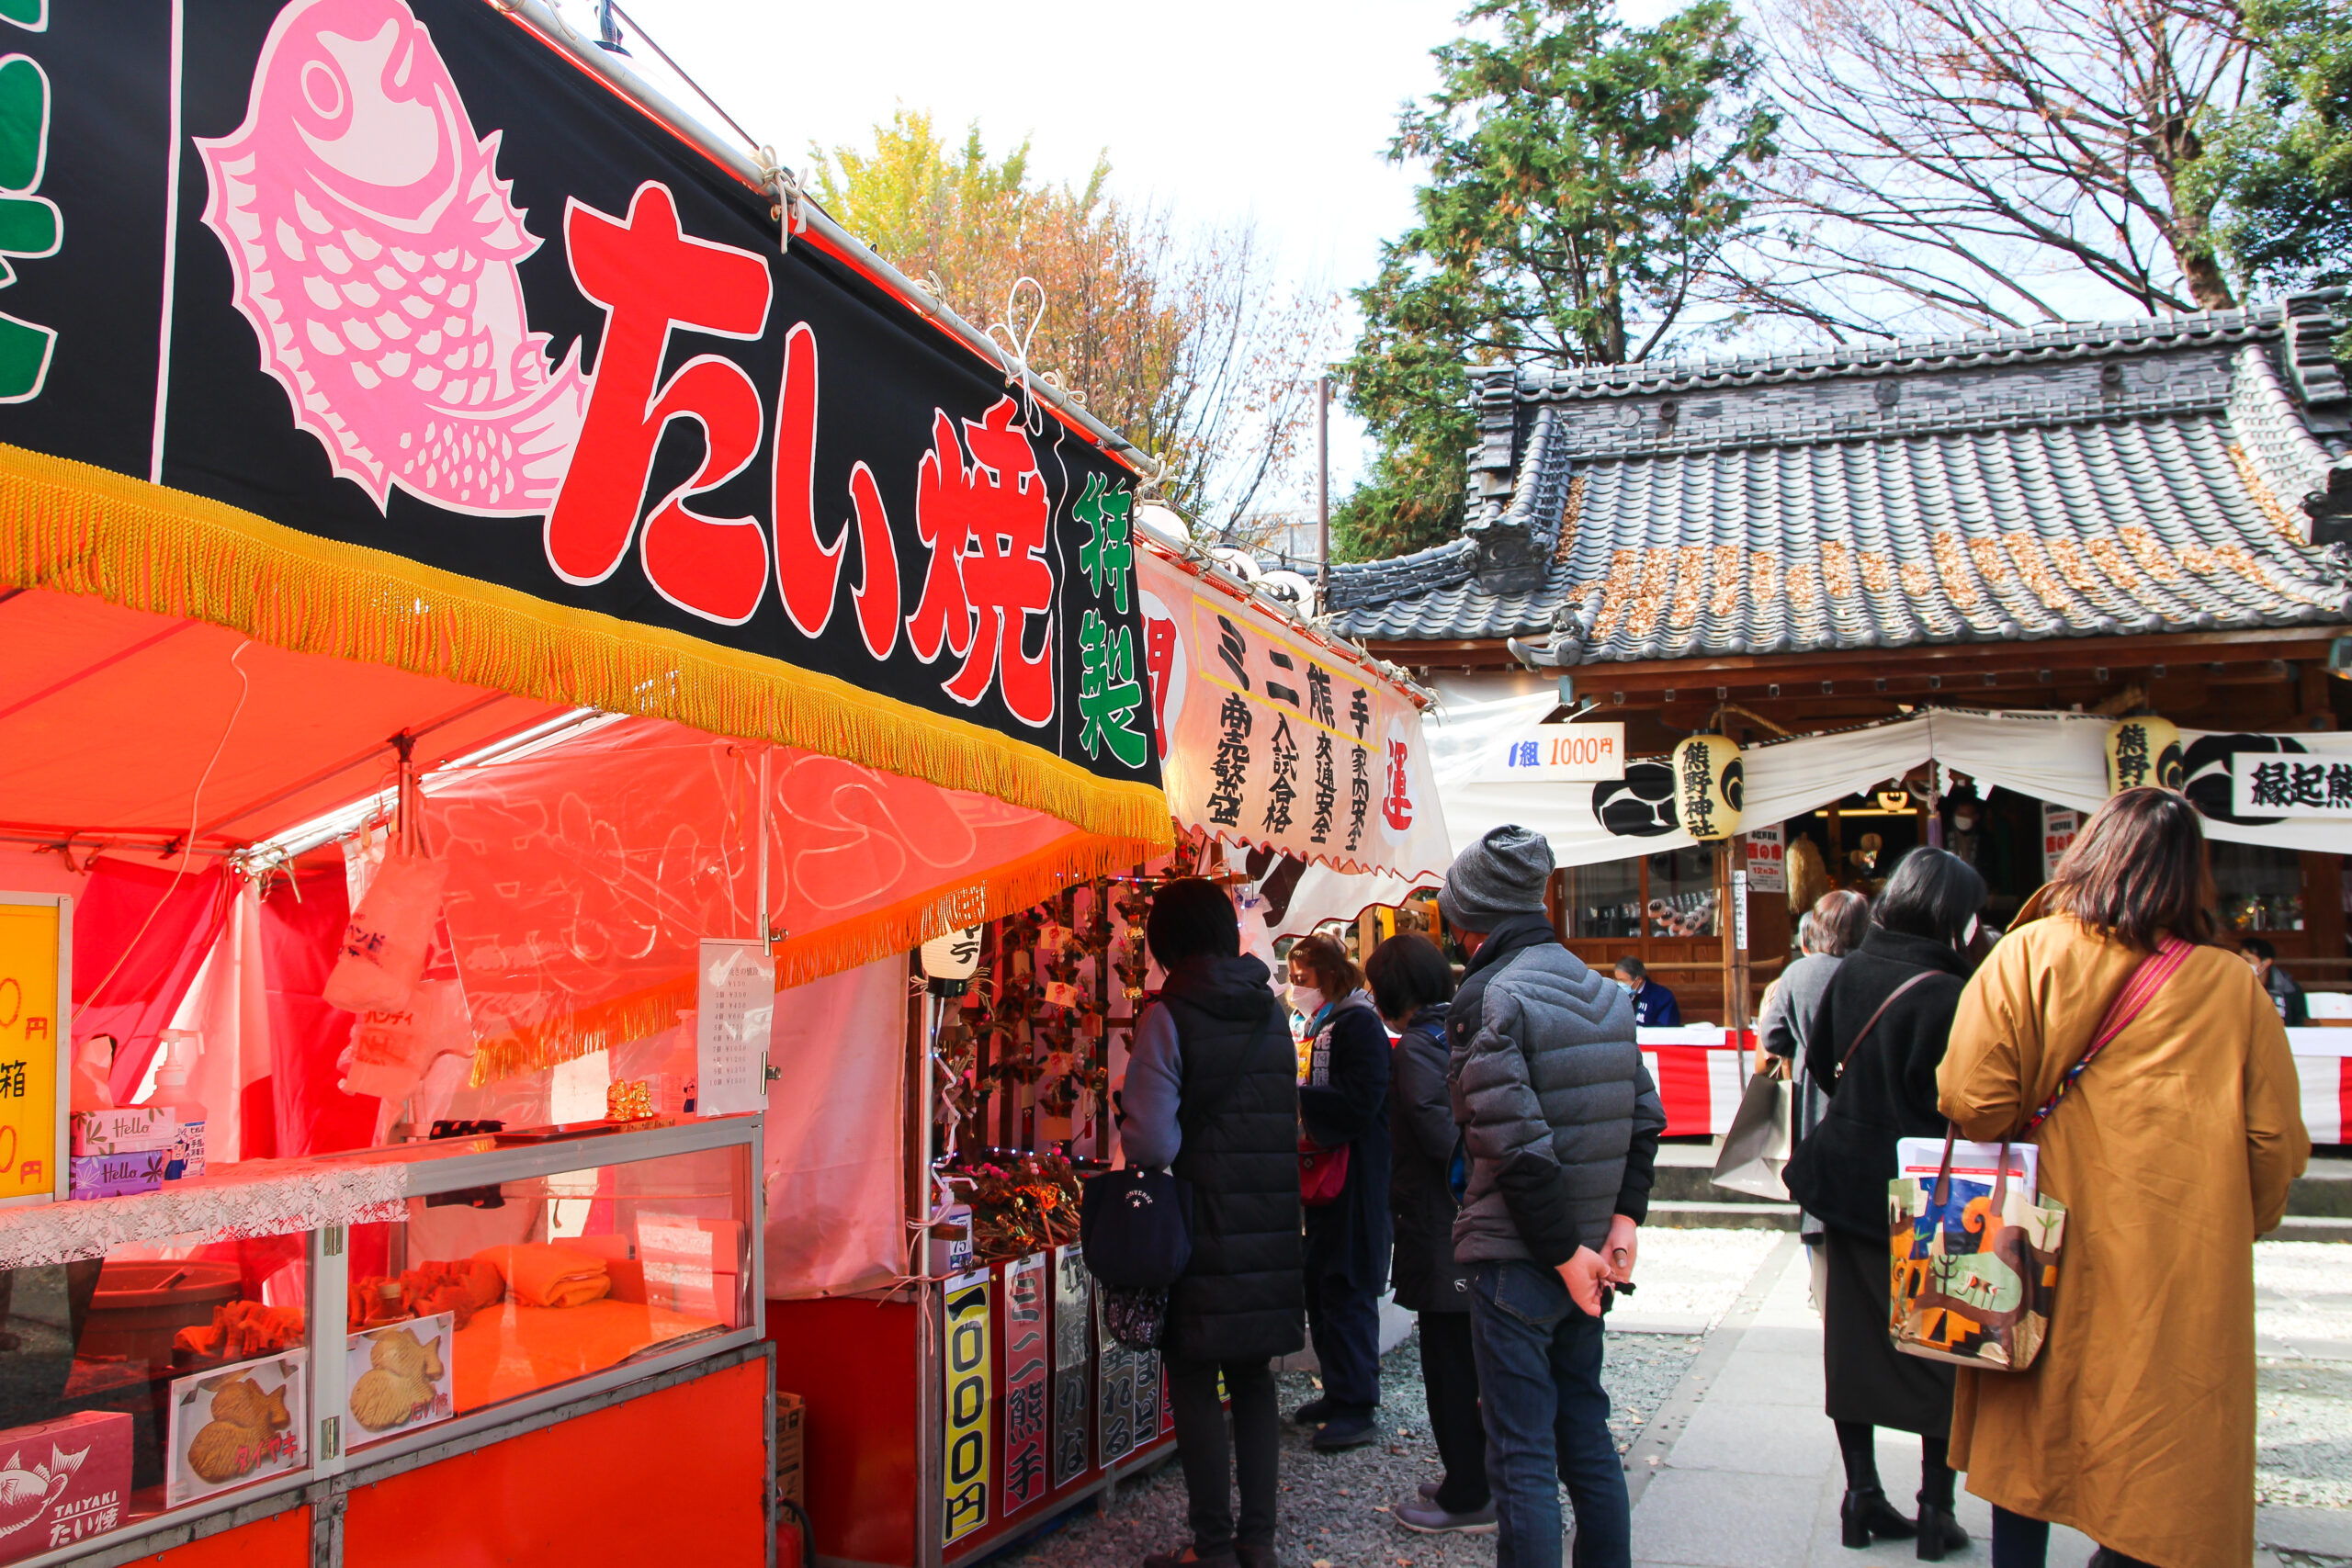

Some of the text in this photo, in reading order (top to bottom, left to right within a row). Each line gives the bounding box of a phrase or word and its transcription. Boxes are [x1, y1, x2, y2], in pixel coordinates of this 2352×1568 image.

[544, 180, 1054, 728] たい焼
[1217, 614, 1370, 739] ミニ熊手
[1206, 692, 1253, 828] 商売繁盛
[1261, 712, 1300, 834] 入試合格
[1310, 731, 1338, 844] 交通安全
[1345, 745, 1370, 852] 家内安全
[1382, 737, 1413, 831] 運
[1509, 738, 1613, 768] 1組 1000円
[1682, 741, 1719, 837] 熊野神社
[2116, 724, 2151, 792] 熊野
[101, 1161, 138, 1184] Hello
[112, 1117, 150, 1138] Hello
[235, 1429, 298, 1474] タイヤキ
[49, 1507, 119, 1548] たい焼
[54, 1490, 117, 1518] TAIYAKI
